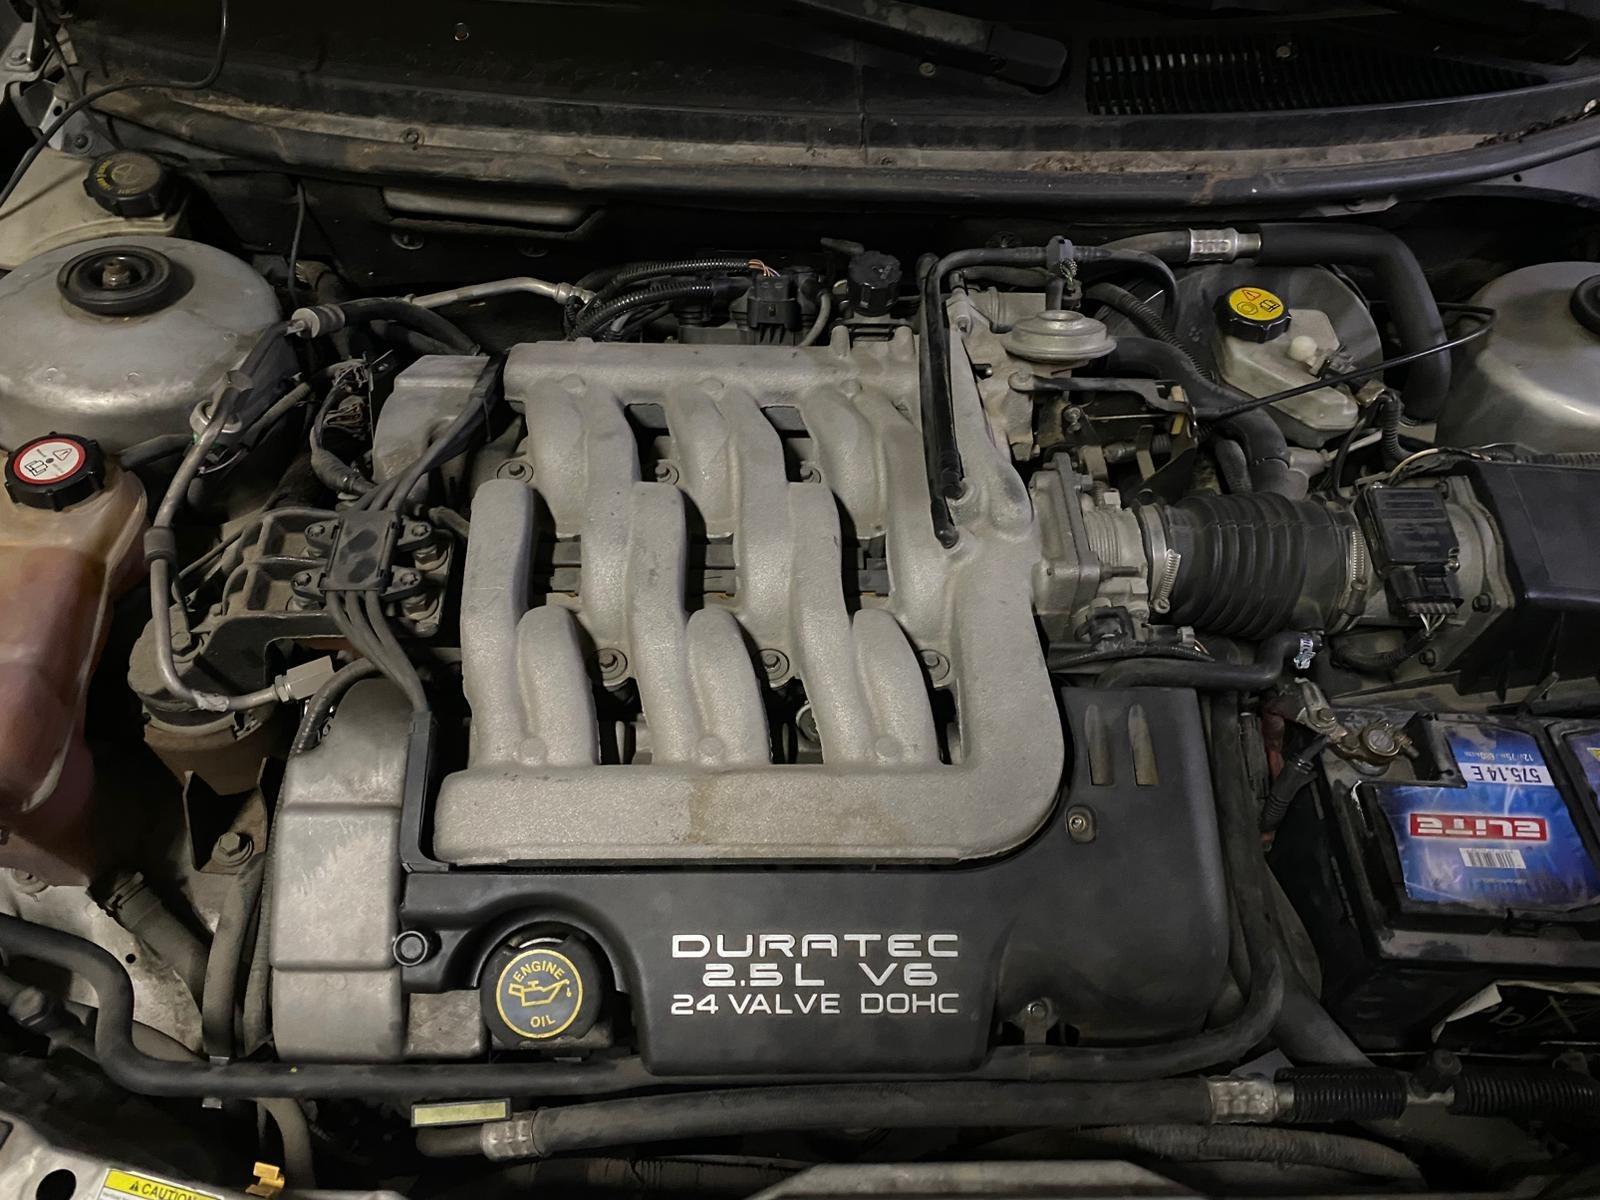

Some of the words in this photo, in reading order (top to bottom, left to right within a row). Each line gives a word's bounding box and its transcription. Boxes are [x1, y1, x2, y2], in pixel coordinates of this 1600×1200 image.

[671, 933, 959, 958] DURATEC
[512, 960, 565, 982] ENGINE
[858, 963, 938, 987] V6
[670, 993, 719, 1015] 24
[727, 993, 841, 1015] VALVE
[860, 993, 959, 1014] DOHC
[530, 1014, 556, 1028] OIL
